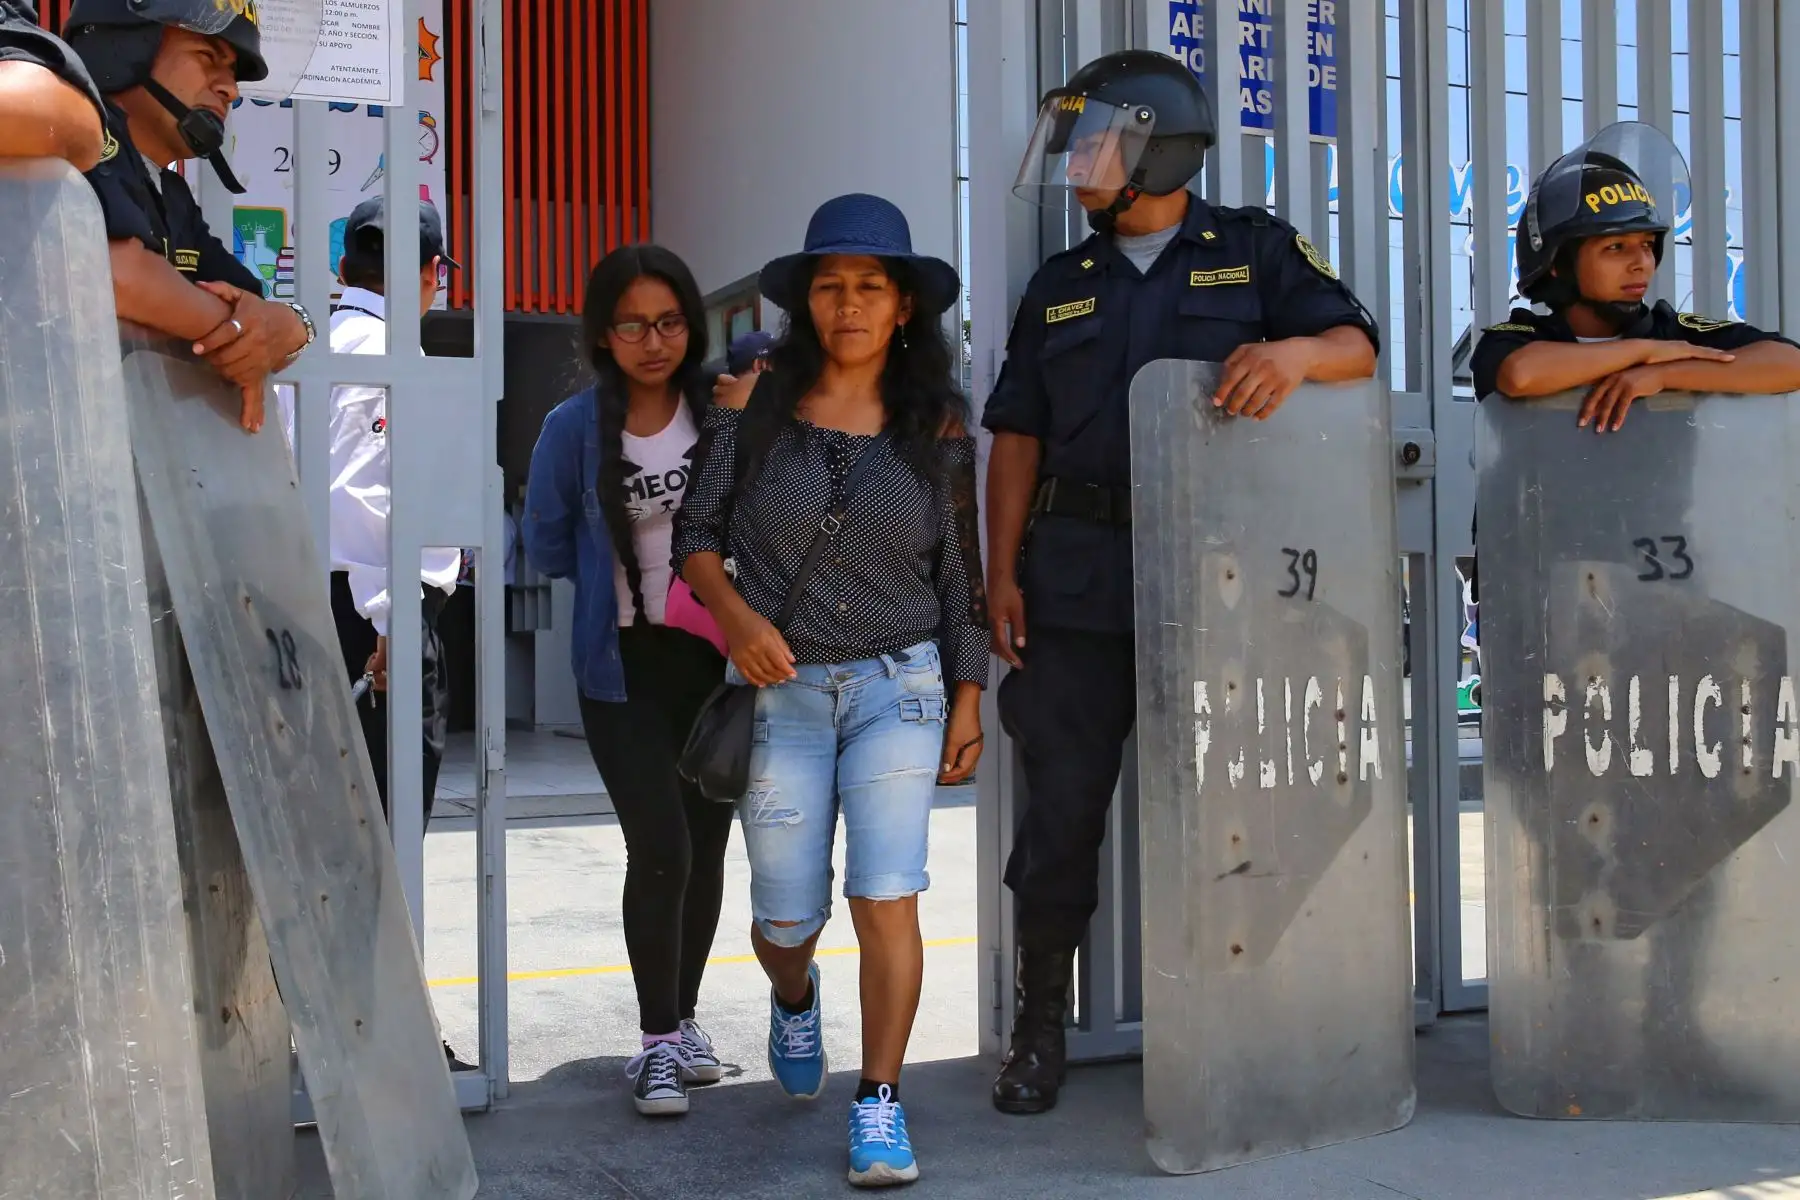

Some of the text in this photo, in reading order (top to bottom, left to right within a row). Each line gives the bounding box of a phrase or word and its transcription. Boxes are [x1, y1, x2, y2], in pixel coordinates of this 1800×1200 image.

[325, 9, 343, 17] 12:00
[340, 1, 380, 11] ALMUERZOS
[351, 22, 380, 30] NOMBRE
[329, 42, 352, 50] APOYO
[1632, 535, 1694, 582] 33
[1278, 548, 1317, 601] 39
[1193, 674, 1383, 796] PLICIA
[1543, 673, 1800, 778] POLICIA
